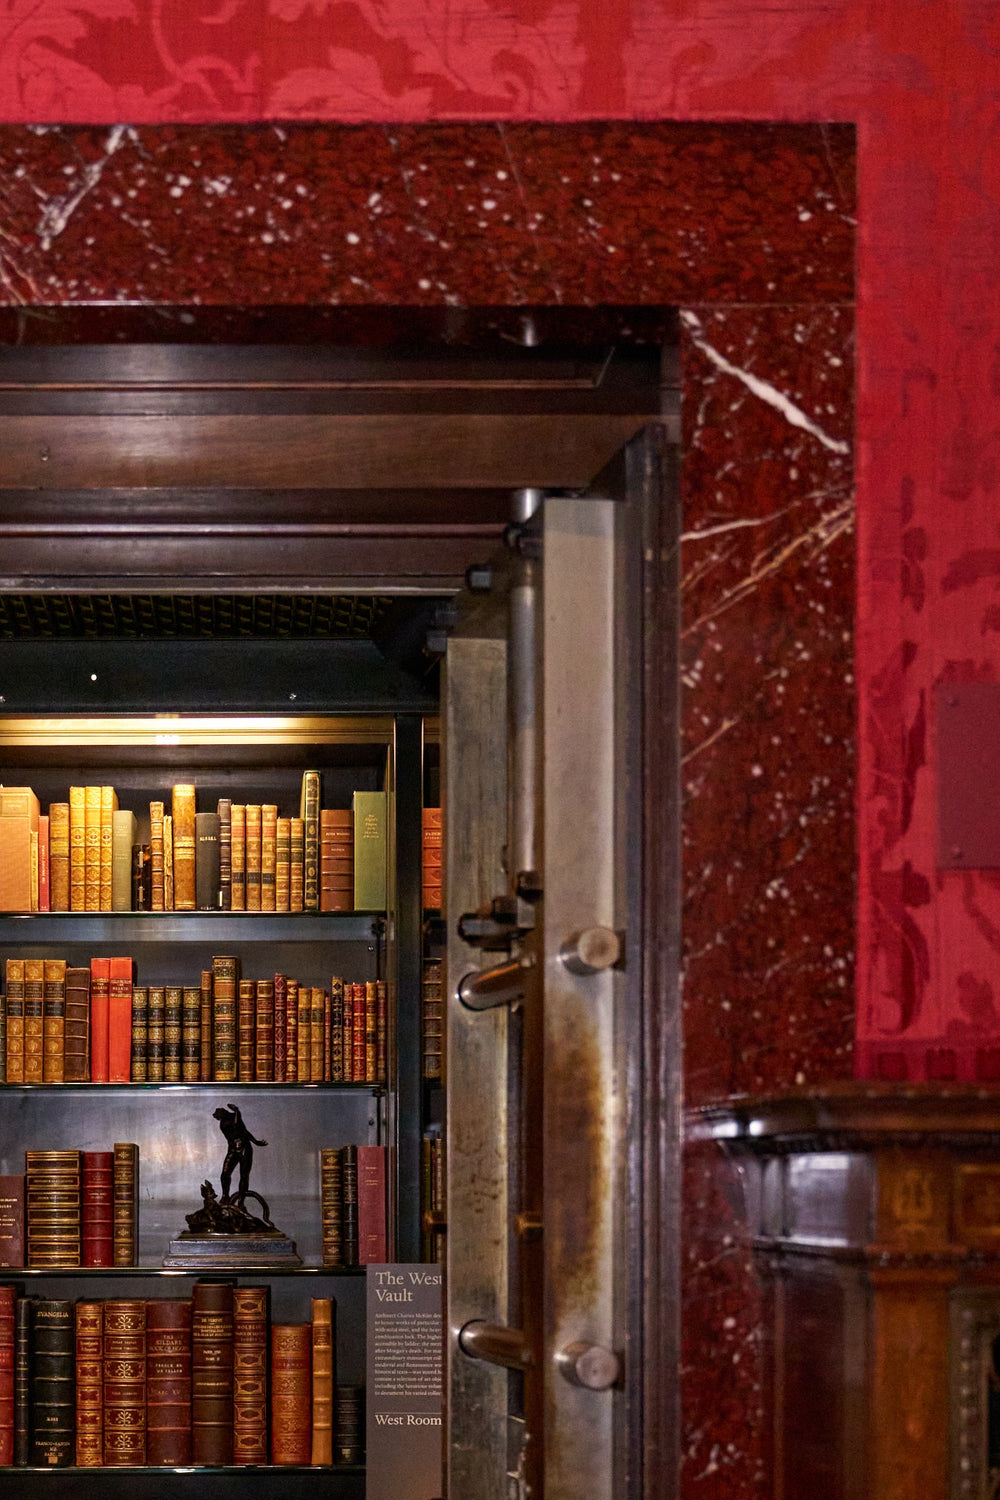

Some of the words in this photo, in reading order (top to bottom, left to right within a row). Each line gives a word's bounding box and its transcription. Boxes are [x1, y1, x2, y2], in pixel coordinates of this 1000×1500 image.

[375, 1271, 404, 1285] The
[408, 1271, 442, 1285] West
[375, 1288, 413, 1302] Vault
[375, 1414, 404, 1426] West
[406, 1414, 443, 1426] Room
